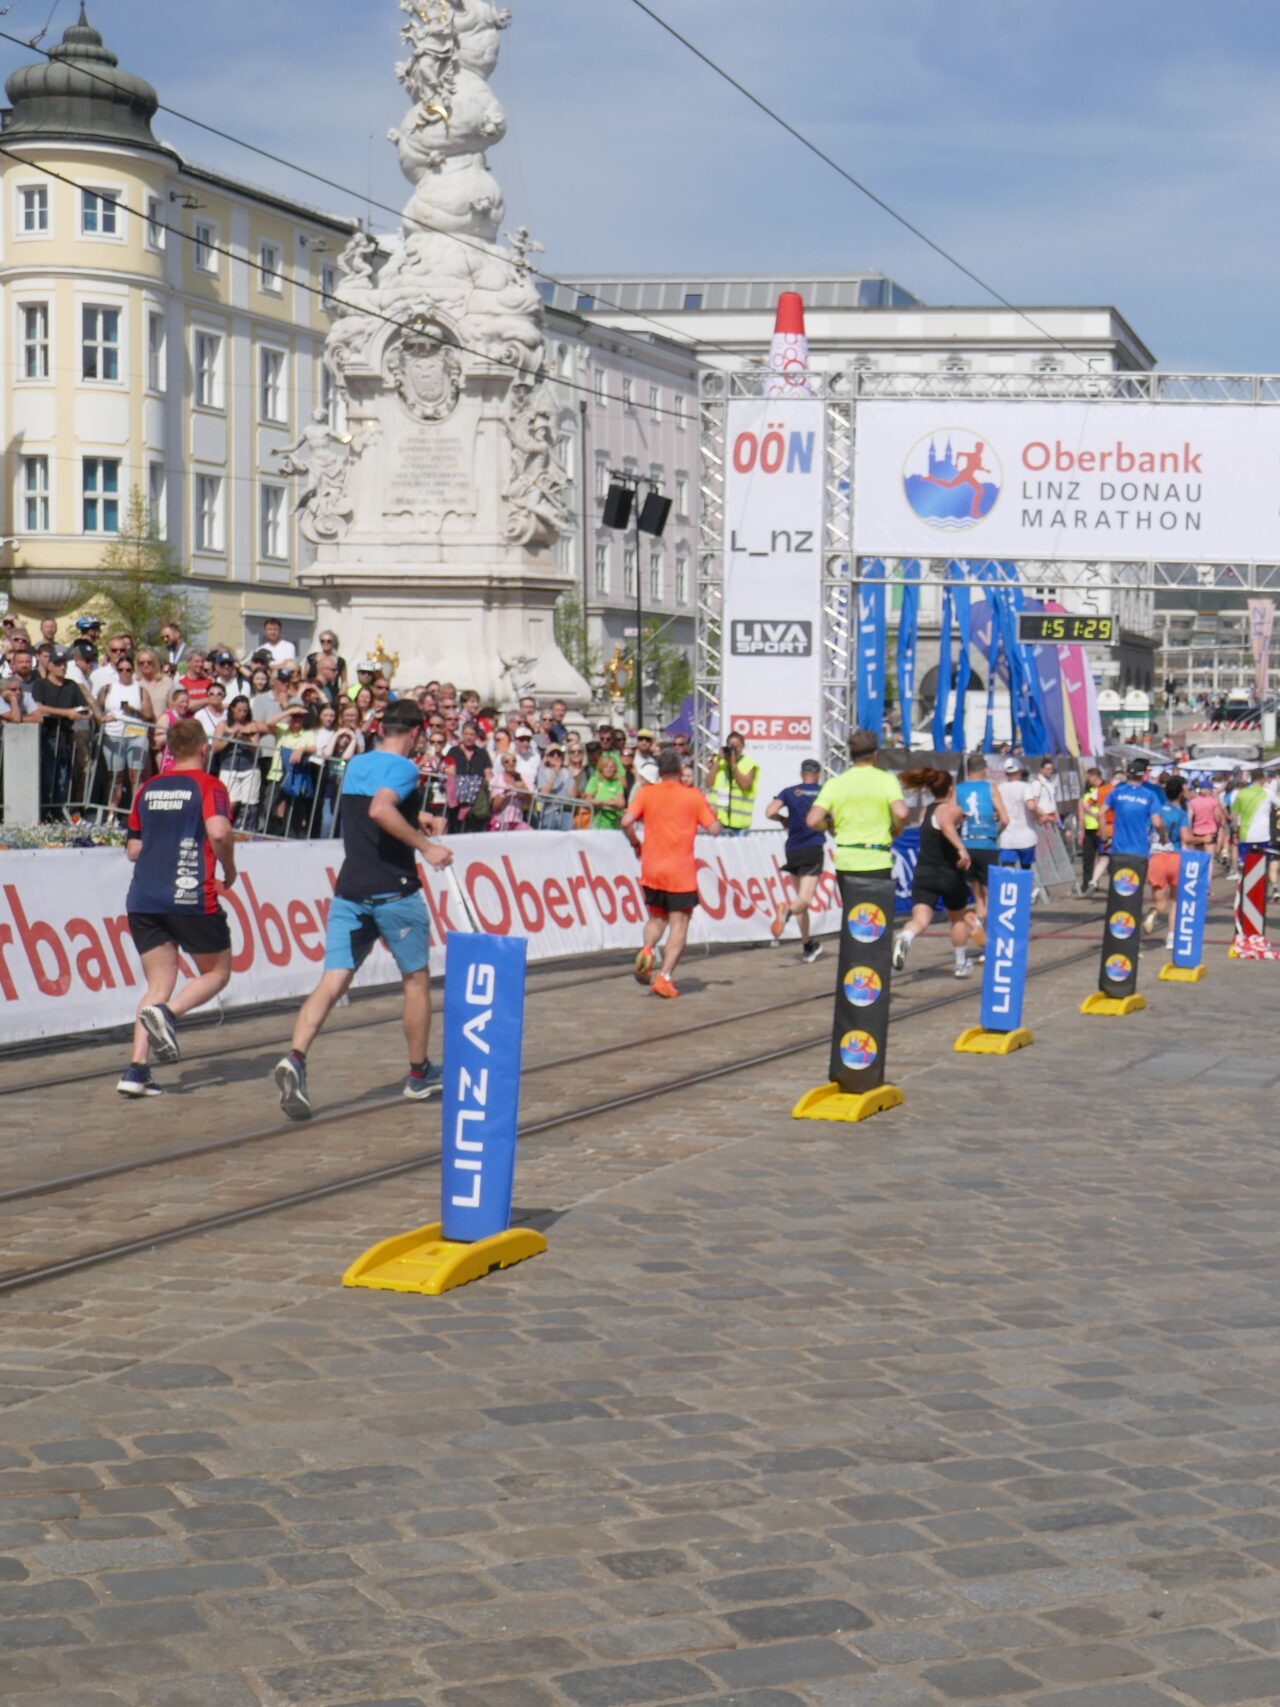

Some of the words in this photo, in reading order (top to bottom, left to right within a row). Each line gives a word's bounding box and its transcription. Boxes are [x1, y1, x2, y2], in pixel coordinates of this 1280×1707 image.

[733, 422, 815, 474] OÖN
[1022, 440, 1203, 473] Oberbank
[1022, 481, 1081, 500] LINZ
[1100, 482, 1201, 502] DONAU
[1022, 509, 1201, 530] MARATHON
[735, 623, 809, 642] LIVA
[735, 642, 809, 654] SPORT
[734, 718, 784, 736] ORF
[145, 790, 192, 801] FEUERWEHR
[1184, 861, 1200, 897] AG
[998, 882, 1018, 932] AG
[1178, 900, 1196, 956] LINZ
[991, 937, 1015, 1013] LINZ
[462, 963, 496, 1054] AG
[452, 1066, 489, 1208] LINZ
